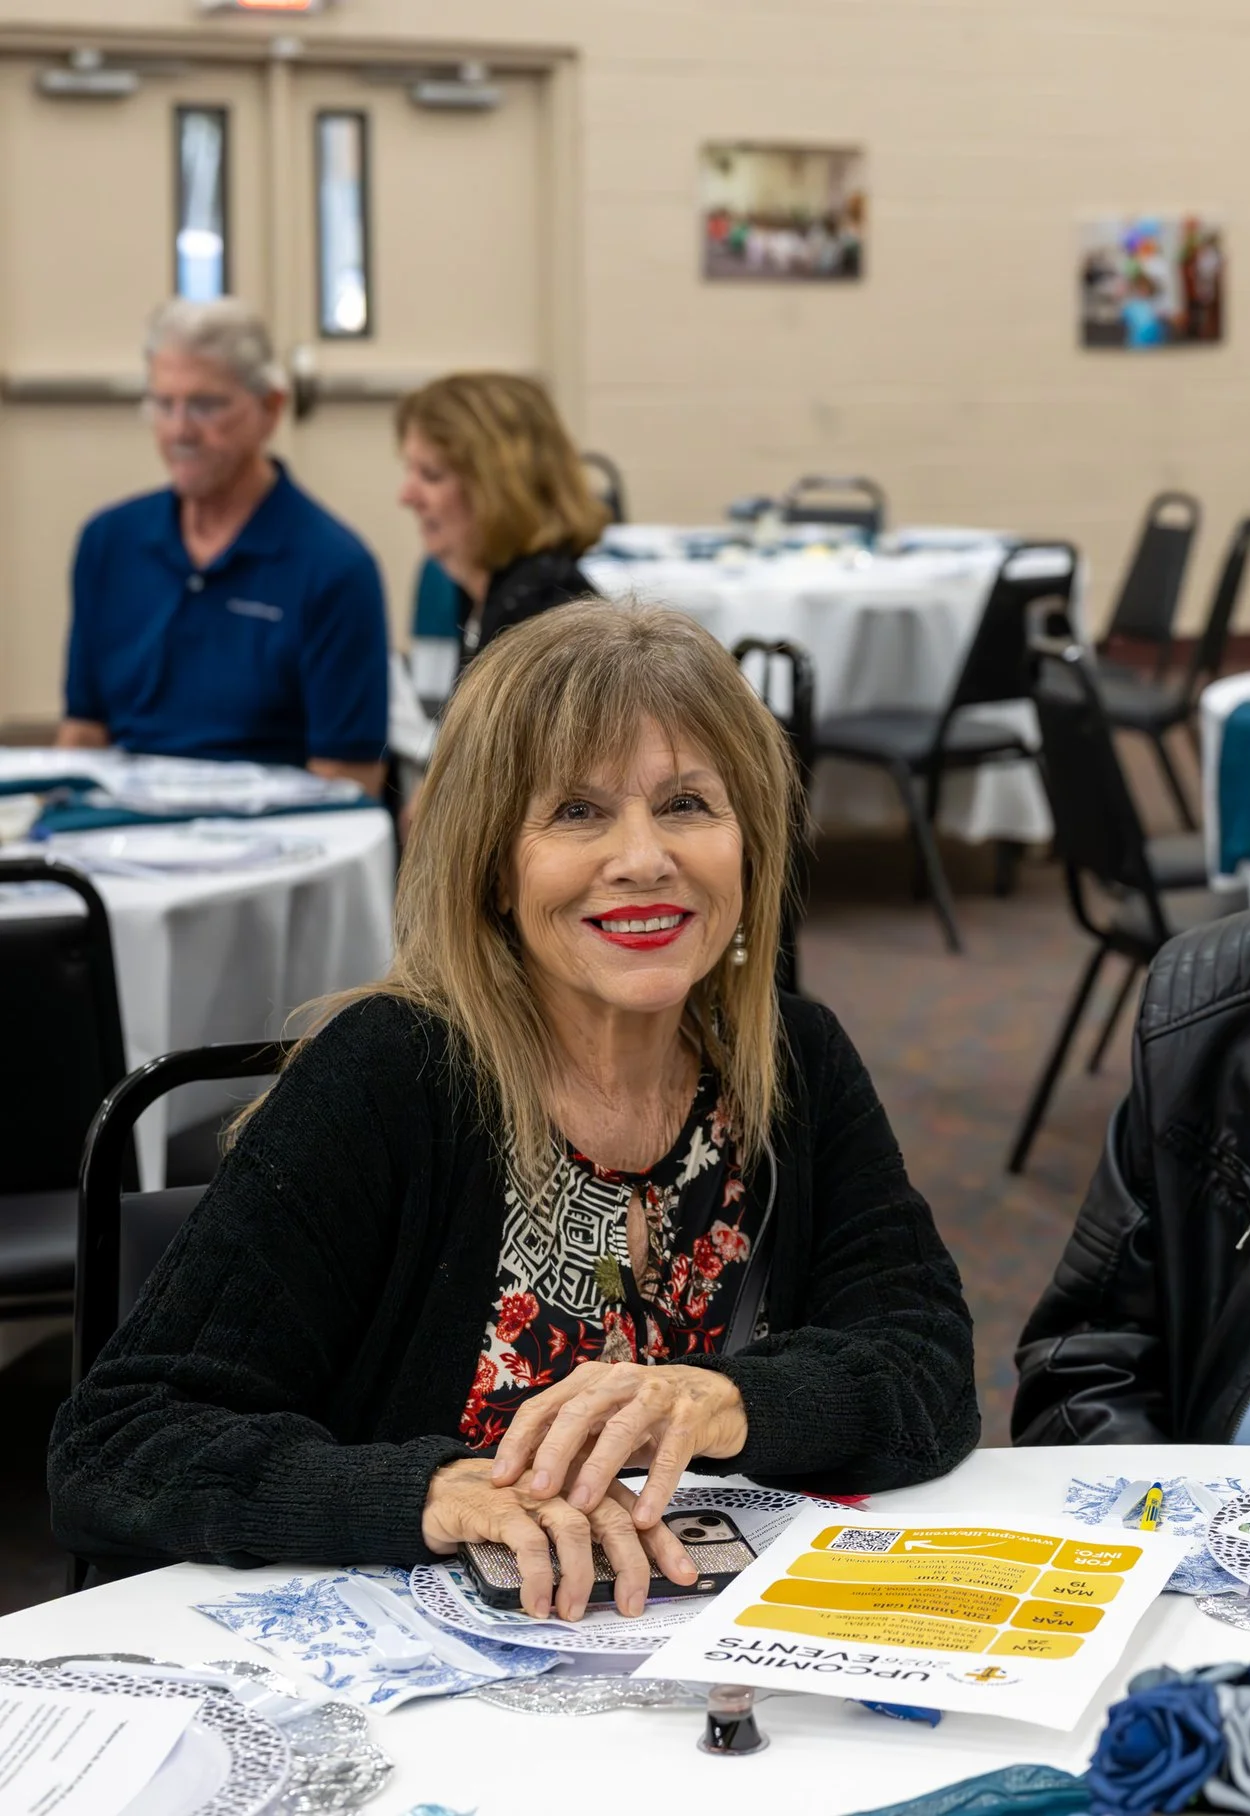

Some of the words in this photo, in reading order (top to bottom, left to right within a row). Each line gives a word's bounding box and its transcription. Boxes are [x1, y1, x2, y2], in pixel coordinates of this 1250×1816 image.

[912, 1531, 1053, 1546] www.cpm.life/events
[1074, 1549, 1122, 1558] INFO:
[1074, 1557, 1112, 1566] FOR
[972, 1567, 1022, 1578] Canaveral
[965, 1579, 1013, 1590] Dinner
[1053, 1587, 1094, 1597] MAR
[907, 1604, 959, 1614] Annual
[963, 1611, 991, 1620] 12th
[1032, 1616, 1074, 1626] MAR
[888, 1624, 946, 1635] Roadhouse
[716, 1637, 879, 1664] EVENTS
[704, 1651, 930, 1682] UPCOMING
[882, 1657, 950, 1669] 2026
